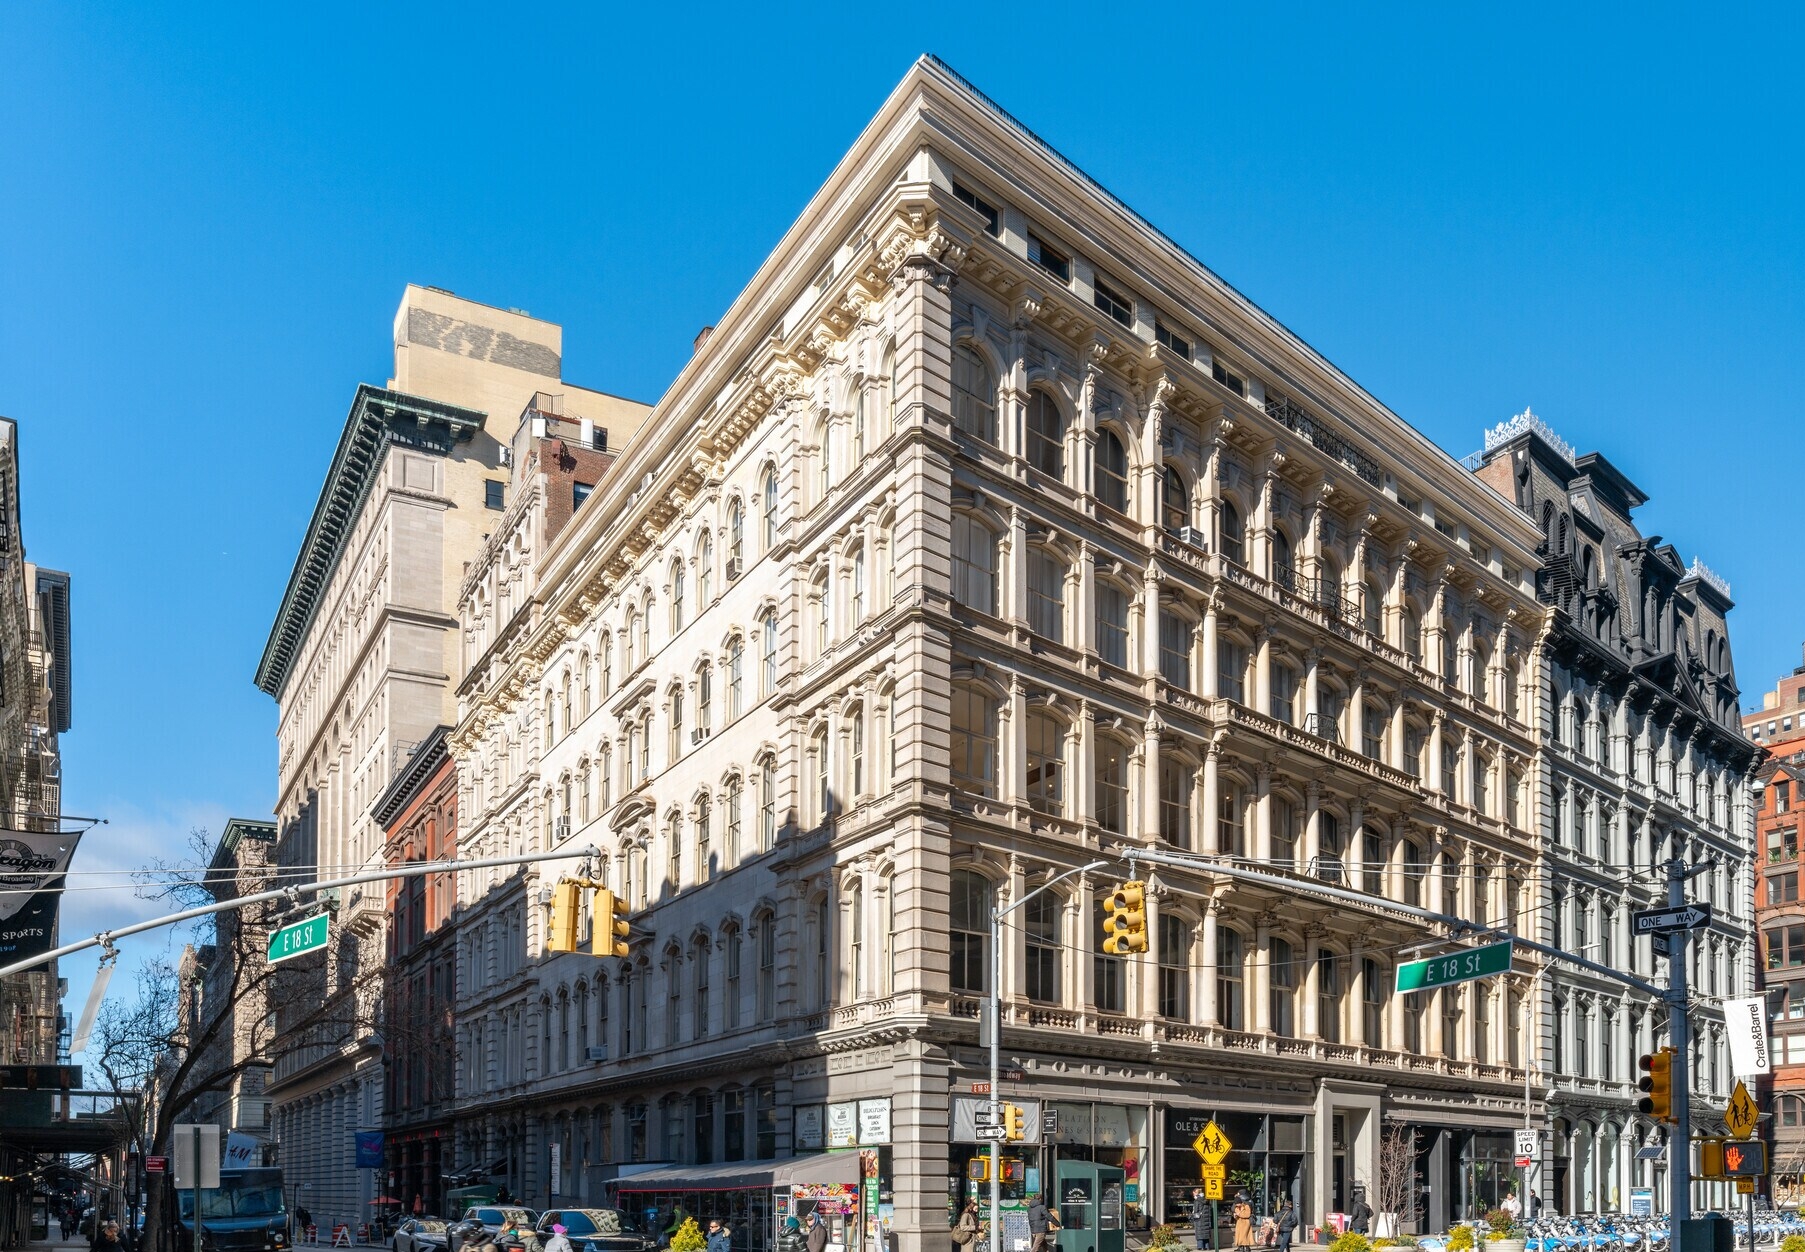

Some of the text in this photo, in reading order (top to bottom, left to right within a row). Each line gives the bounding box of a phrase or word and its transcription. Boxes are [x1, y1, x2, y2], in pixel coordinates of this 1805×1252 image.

[2, 874, 34, 882] Broadway
[1641, 911, 1698, 928] ONE WAY
[2, 928, 43, 940] SPORTS
[284, 925, 313, 952] E 18 St
[1654, 937, 1664, 950] ONE
[1426, 953, 1480, 982] E 18 St
[1747, 1003, 1766, 1068] Crate&Barrel
[983, 1084, 990, 1092] St
[1176, 1121, 1191, 1132] OLE
[1193, 1122, 1199, 1132] &
[1520, 1143, 1533, 1153] 10
[1211, 1180, 1217, 1190] 5
